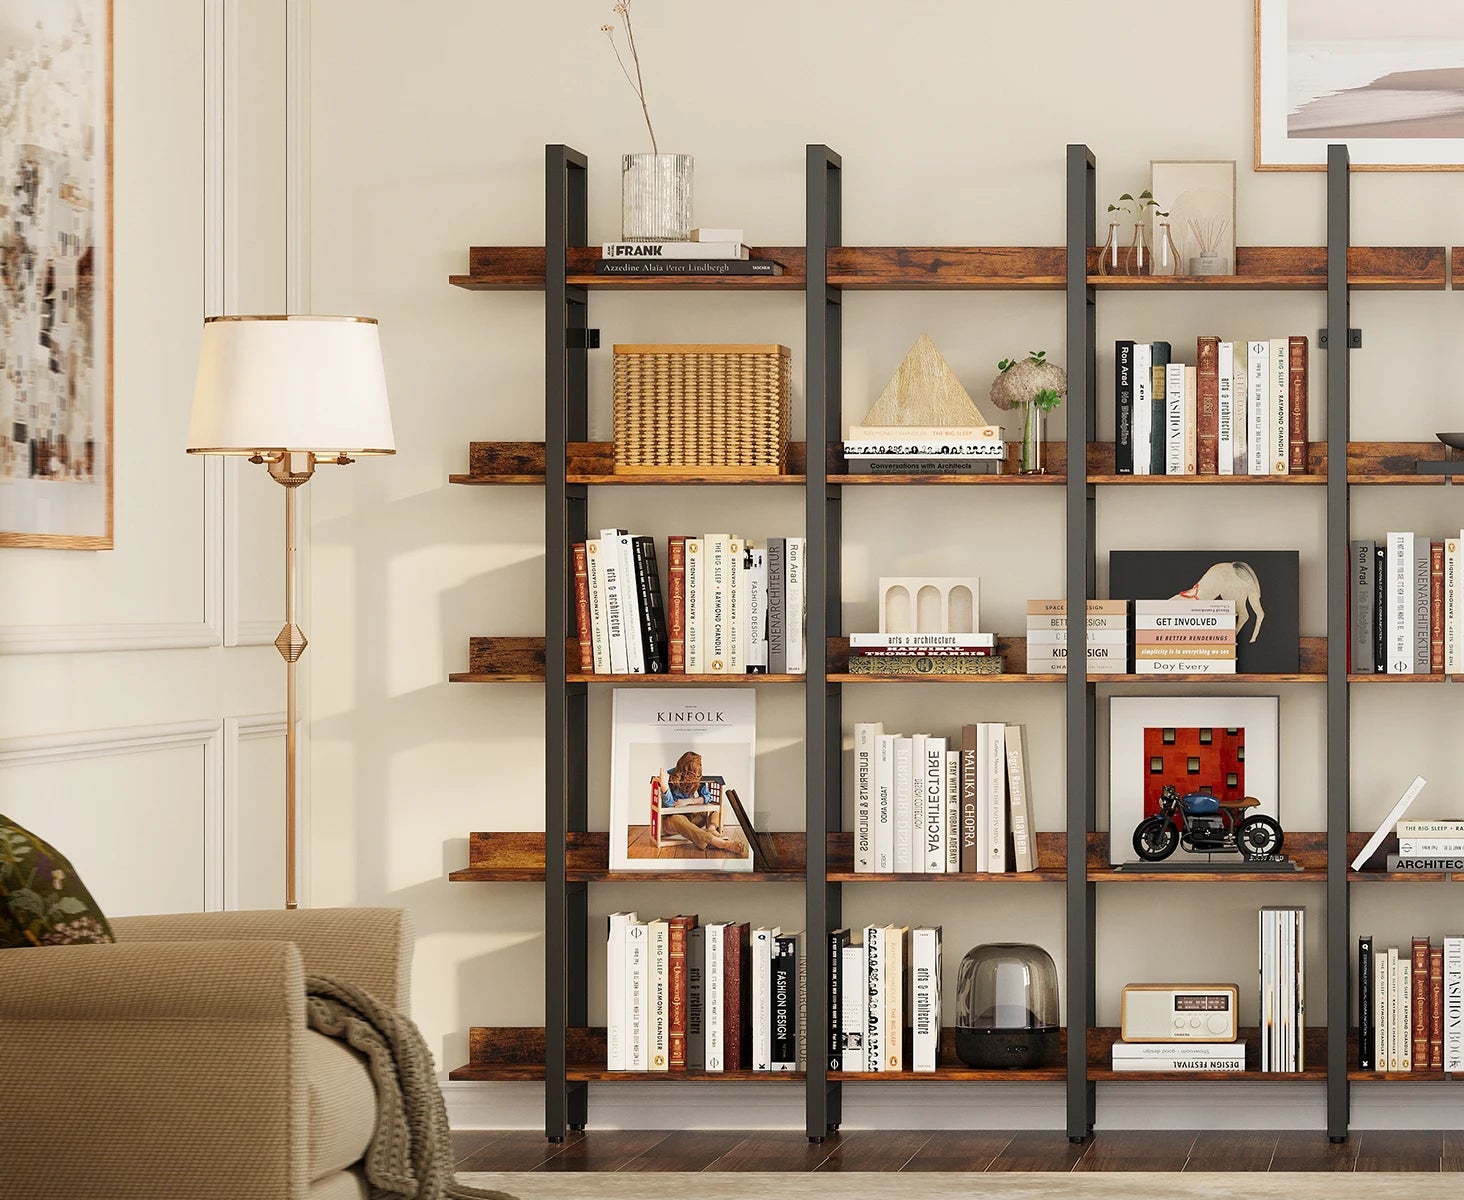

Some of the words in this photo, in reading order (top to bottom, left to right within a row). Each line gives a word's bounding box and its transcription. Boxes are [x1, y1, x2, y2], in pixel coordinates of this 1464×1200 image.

[616, 245, 663, 256] FRANK
[689, 263, 729, 273] Lindbergh
[1121, 347, 1129, 365] Ron
[1121, 366, 1129, 386] Arad
[1170, 366, 1180, 389] THE
[1170, 391, 1180, 438] FASHION
[1170, 441, 1180, 473] BOOK
[714, 542, 722, 553] THE
[790, 544, 798, 562] Ron
[714, 555, 722, 565] BIG
[714, 566, 722, 584] SLEEP
[790, 564, 798, 584] Arad
[714, 591, 722, 623] RAYMOND
[768, 546, 782, 655] INNENARCHITEKTUR
[1156, 618, 1171, 626] GET
[1175, 618, 1217, 626] INVOLVED
[1418, 558, 1428, 666] INNENARCHITEKTUR
[714, 624, 722, 656] CHANDLER
[1153, 662, 1176, 671] Day
[1178, 662, 1209, 671] Every
[657, 712, 724, 722] KINFOLK
[949, 762, 957, 775] STAY
[964, 749, 975, 797] MALLIKA
[1008, 751, 1020, 773] Sigrid
[949, 777, 957, 793] WITH
[1012, 776, 1021, 806] Rausing
[949, 795, 957, 804] ME
[964, 804, 975, 847] CHOPRA
[1014, 816, 1027, 855] mayhem
[1449, 941, 1461, 968] THE
[917, 968, 930, 981] arts
[777, 971, 786, 1007] FASHION
[1449, 972, 1461, 1028] FASHION
[777, 1009, 786, 1040] DESIGN
[917, 993, 930, 1034] architecture
[1449, 1032, 1461, 1068] BOOK
